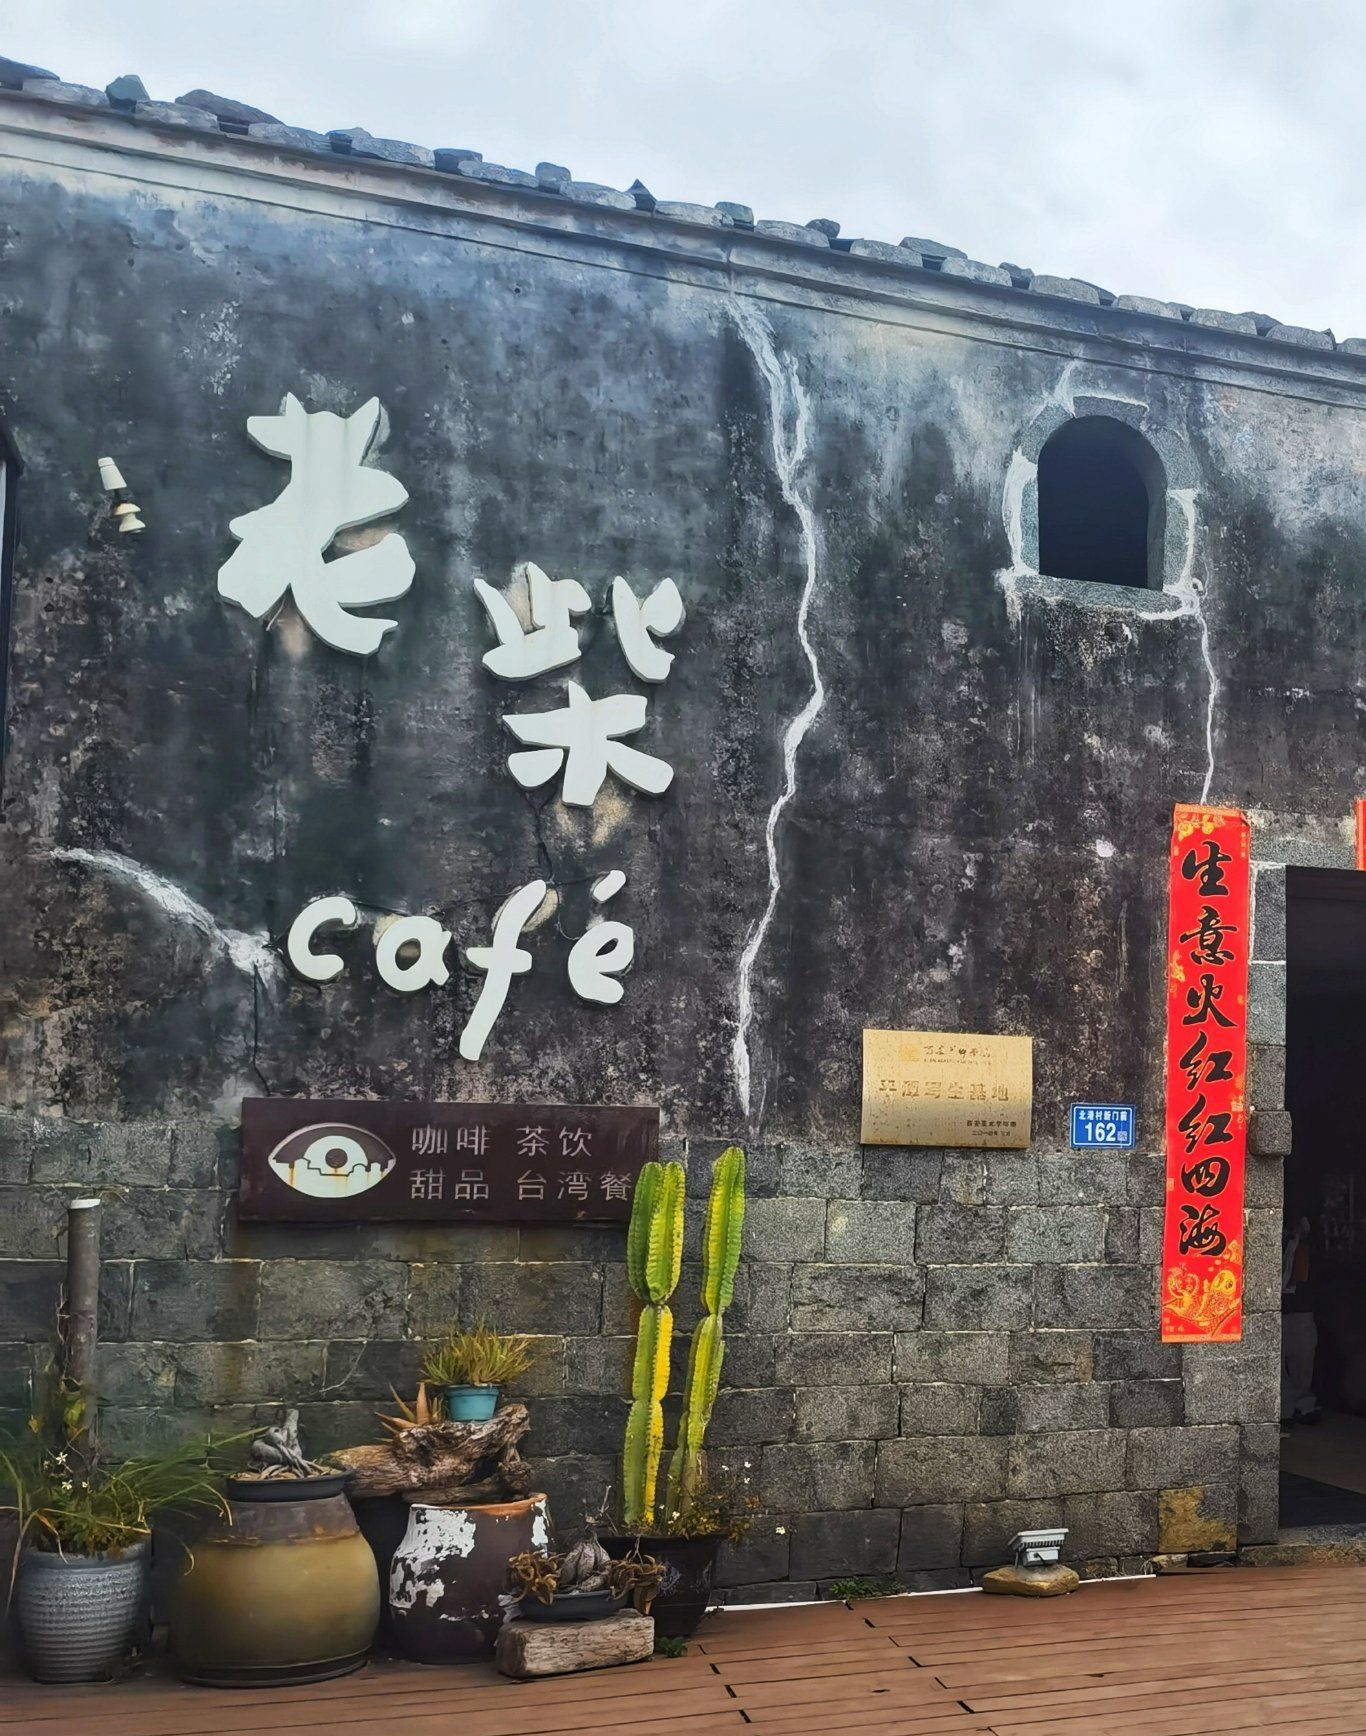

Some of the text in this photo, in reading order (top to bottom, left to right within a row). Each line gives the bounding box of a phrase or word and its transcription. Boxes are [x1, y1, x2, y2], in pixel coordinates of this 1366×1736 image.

[287, 869, 636, 1061] café
[1178, 840, 1238, 1257] 生意火红红四海
[411, 1123, 593, 1157] 咖啡 茶饮
[1084, 1121, 1116, 1142] 162
[409, 1167, 633, 1201] 甜品 台湾餐
